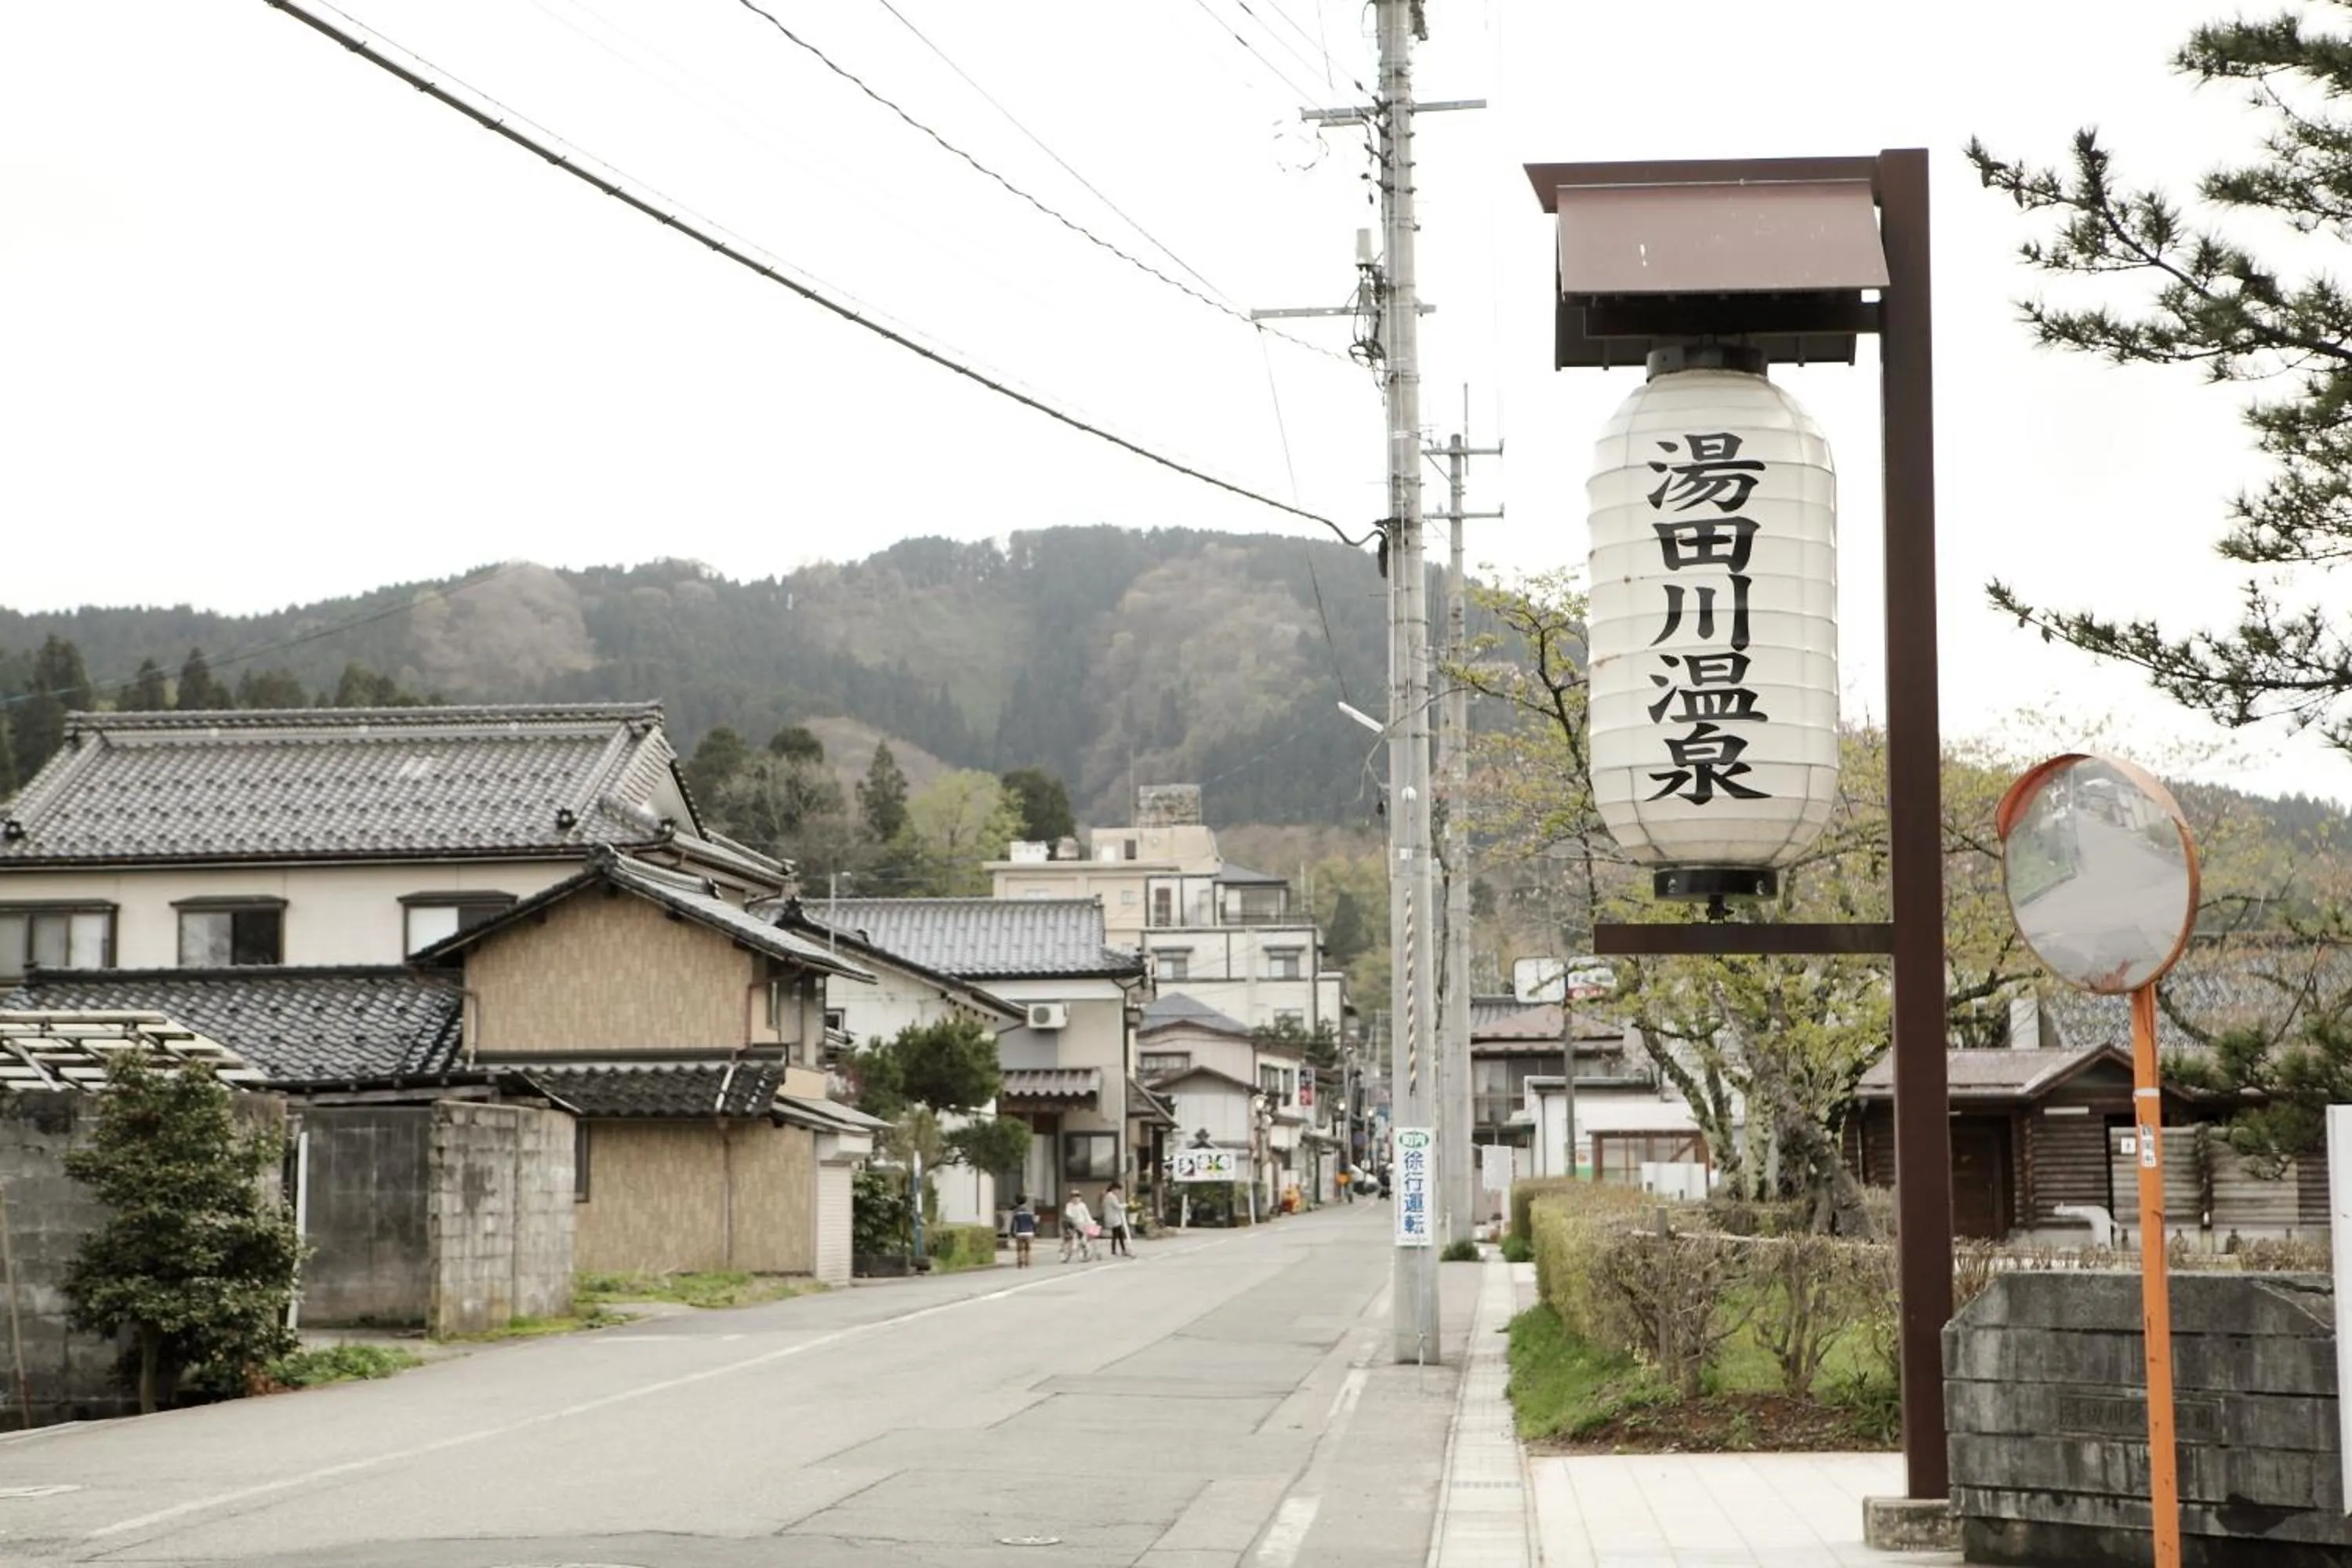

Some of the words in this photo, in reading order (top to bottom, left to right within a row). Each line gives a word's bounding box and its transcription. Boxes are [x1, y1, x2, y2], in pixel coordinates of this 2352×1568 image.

[1646, 432, 1773, 805] 湯田川温泉
[1404, 1150, 1425, 1234] 徐行運転
